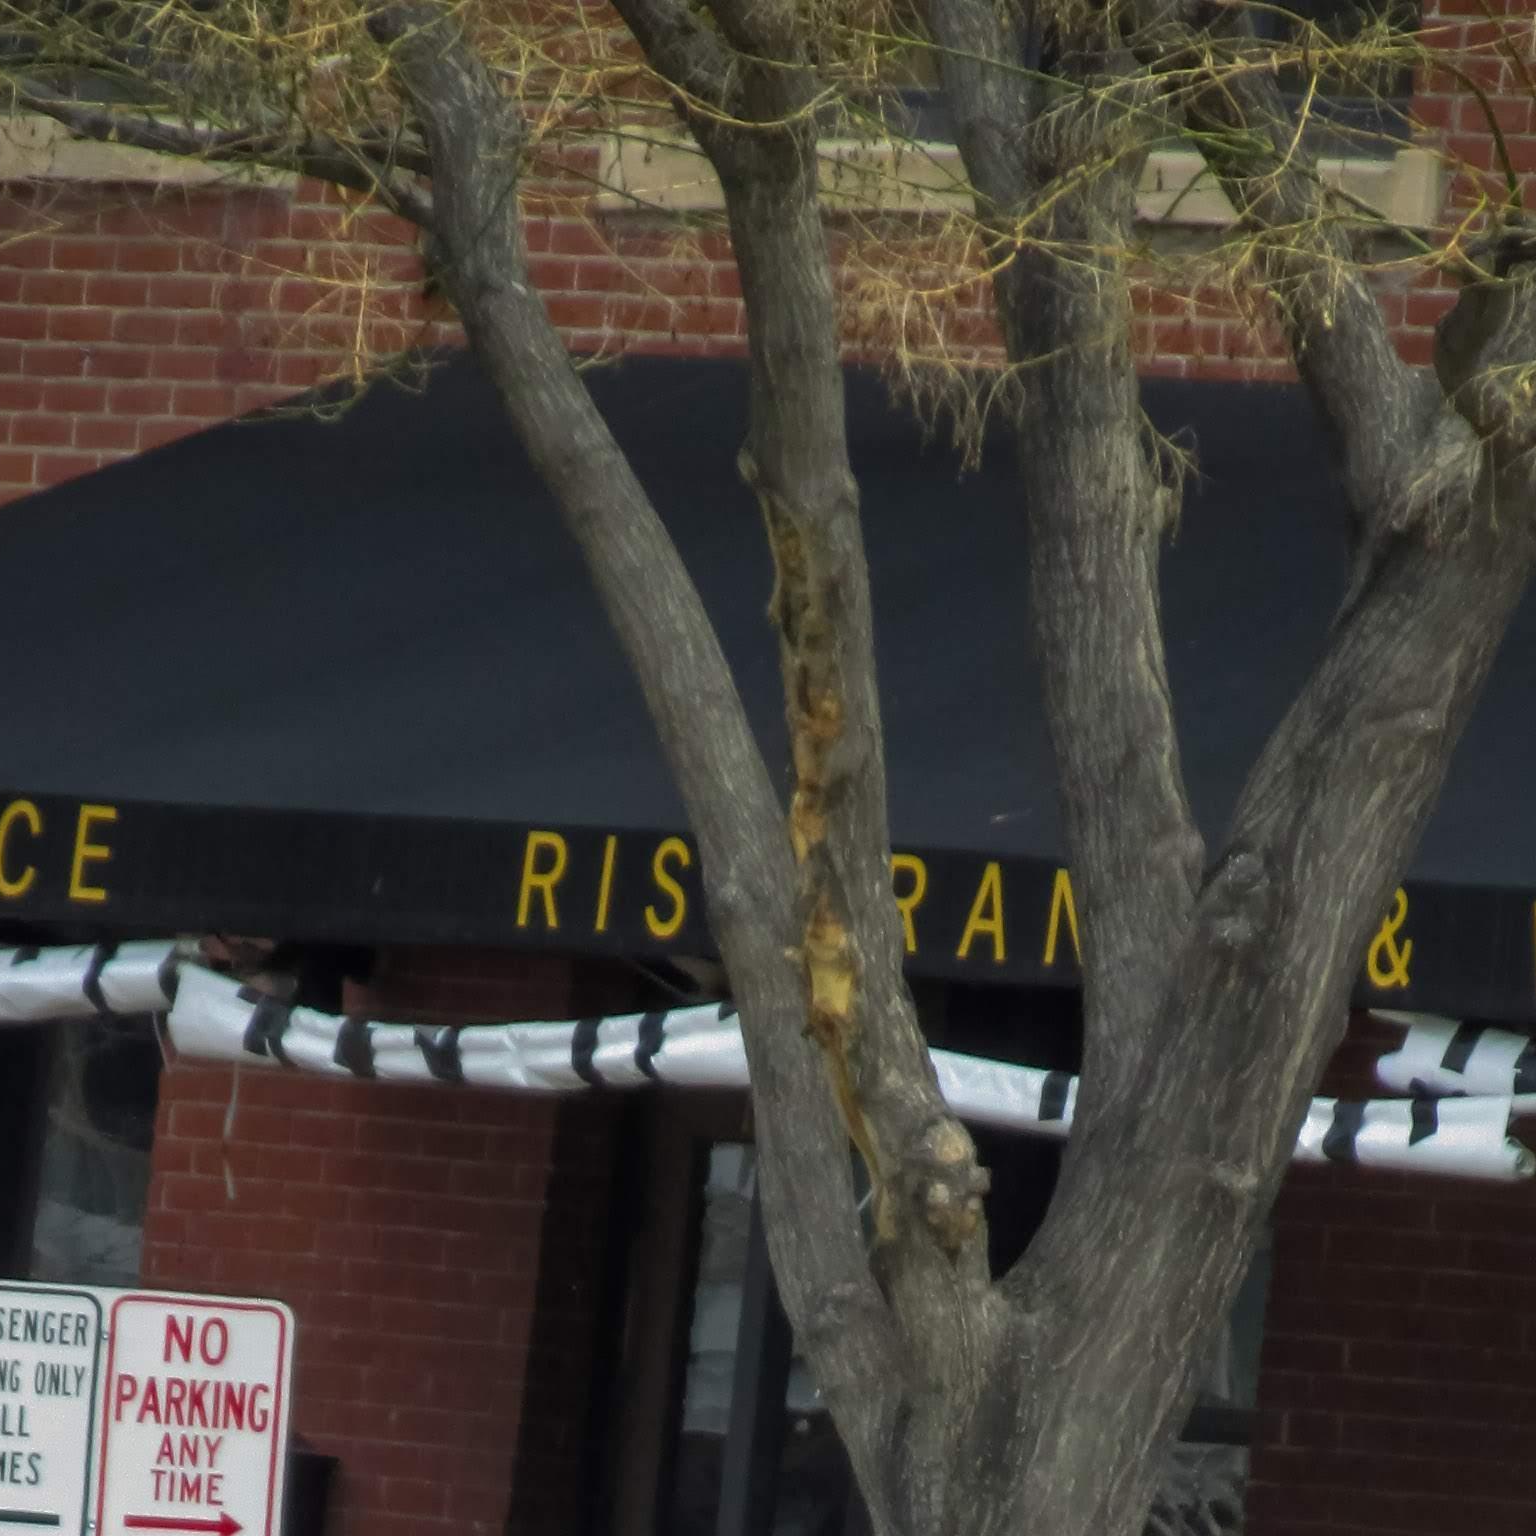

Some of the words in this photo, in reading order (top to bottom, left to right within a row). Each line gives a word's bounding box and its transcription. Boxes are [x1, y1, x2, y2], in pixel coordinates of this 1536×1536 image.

[516, 830, 1084, 966] RISRAN
[1368, 886, 1412, 986] &
[165, 1315, 229, 1367] NO
[34, 1361, 87, 1399] ONLY
[114, 1374, 270, 1433] PARKING
[156, 1433, 224, 1468] ANY
[150, 1469, 225, 1506] TIME
